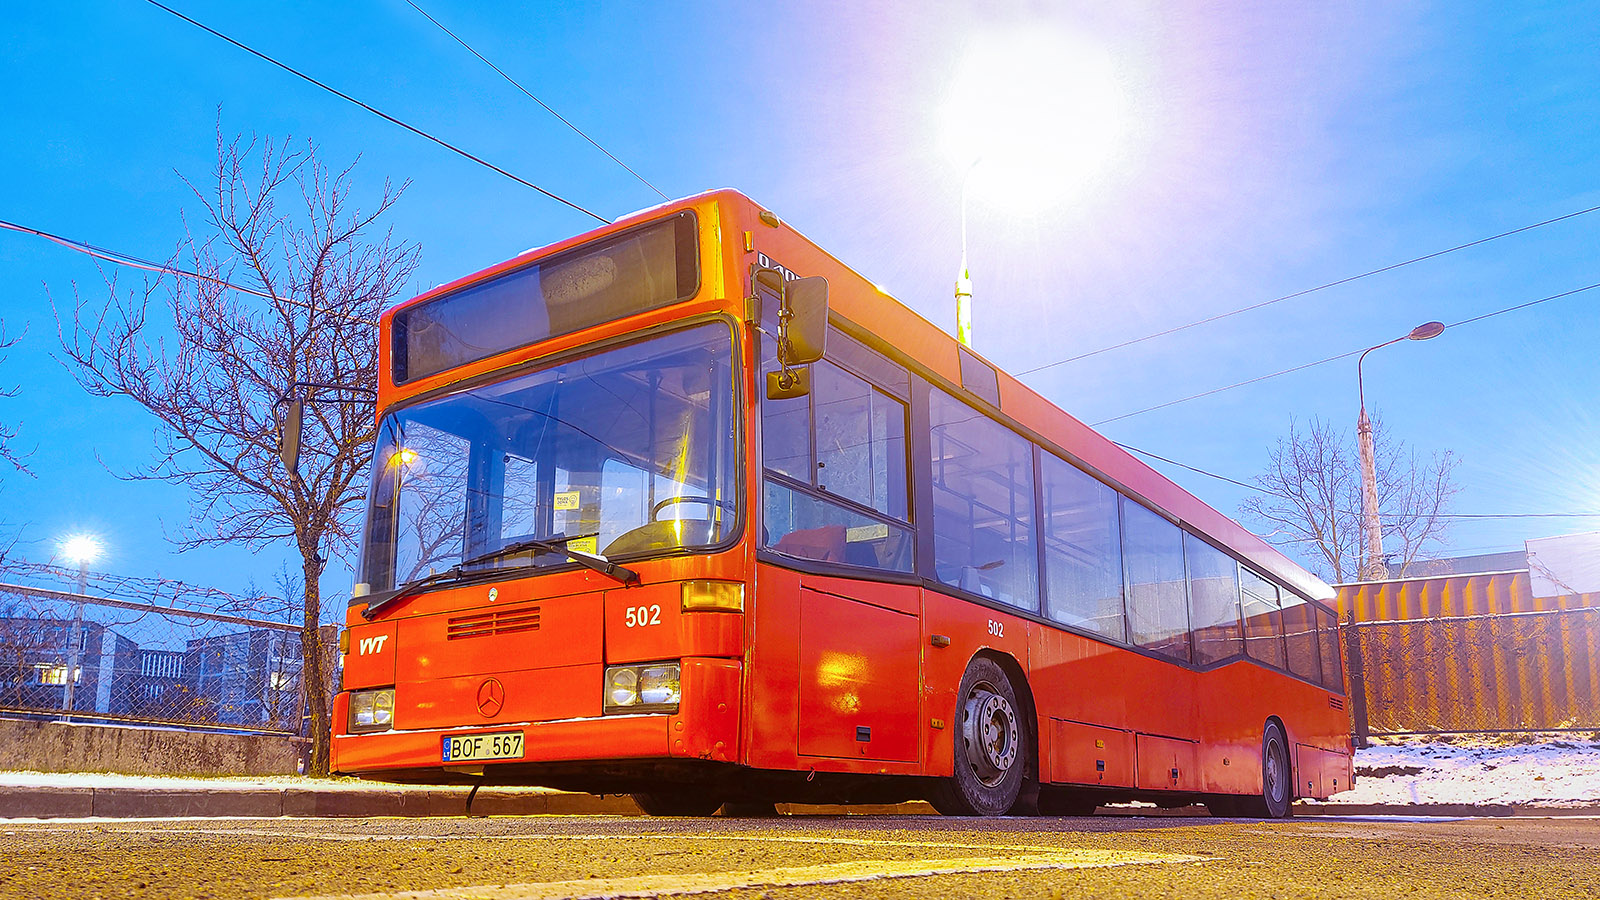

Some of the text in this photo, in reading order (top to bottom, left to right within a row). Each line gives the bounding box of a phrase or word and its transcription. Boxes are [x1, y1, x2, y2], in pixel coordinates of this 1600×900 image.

[625, 604, 661, 628] 502
[987, 619, 1004, 638] 502
[452, 736, 522, 758] BOF 567
